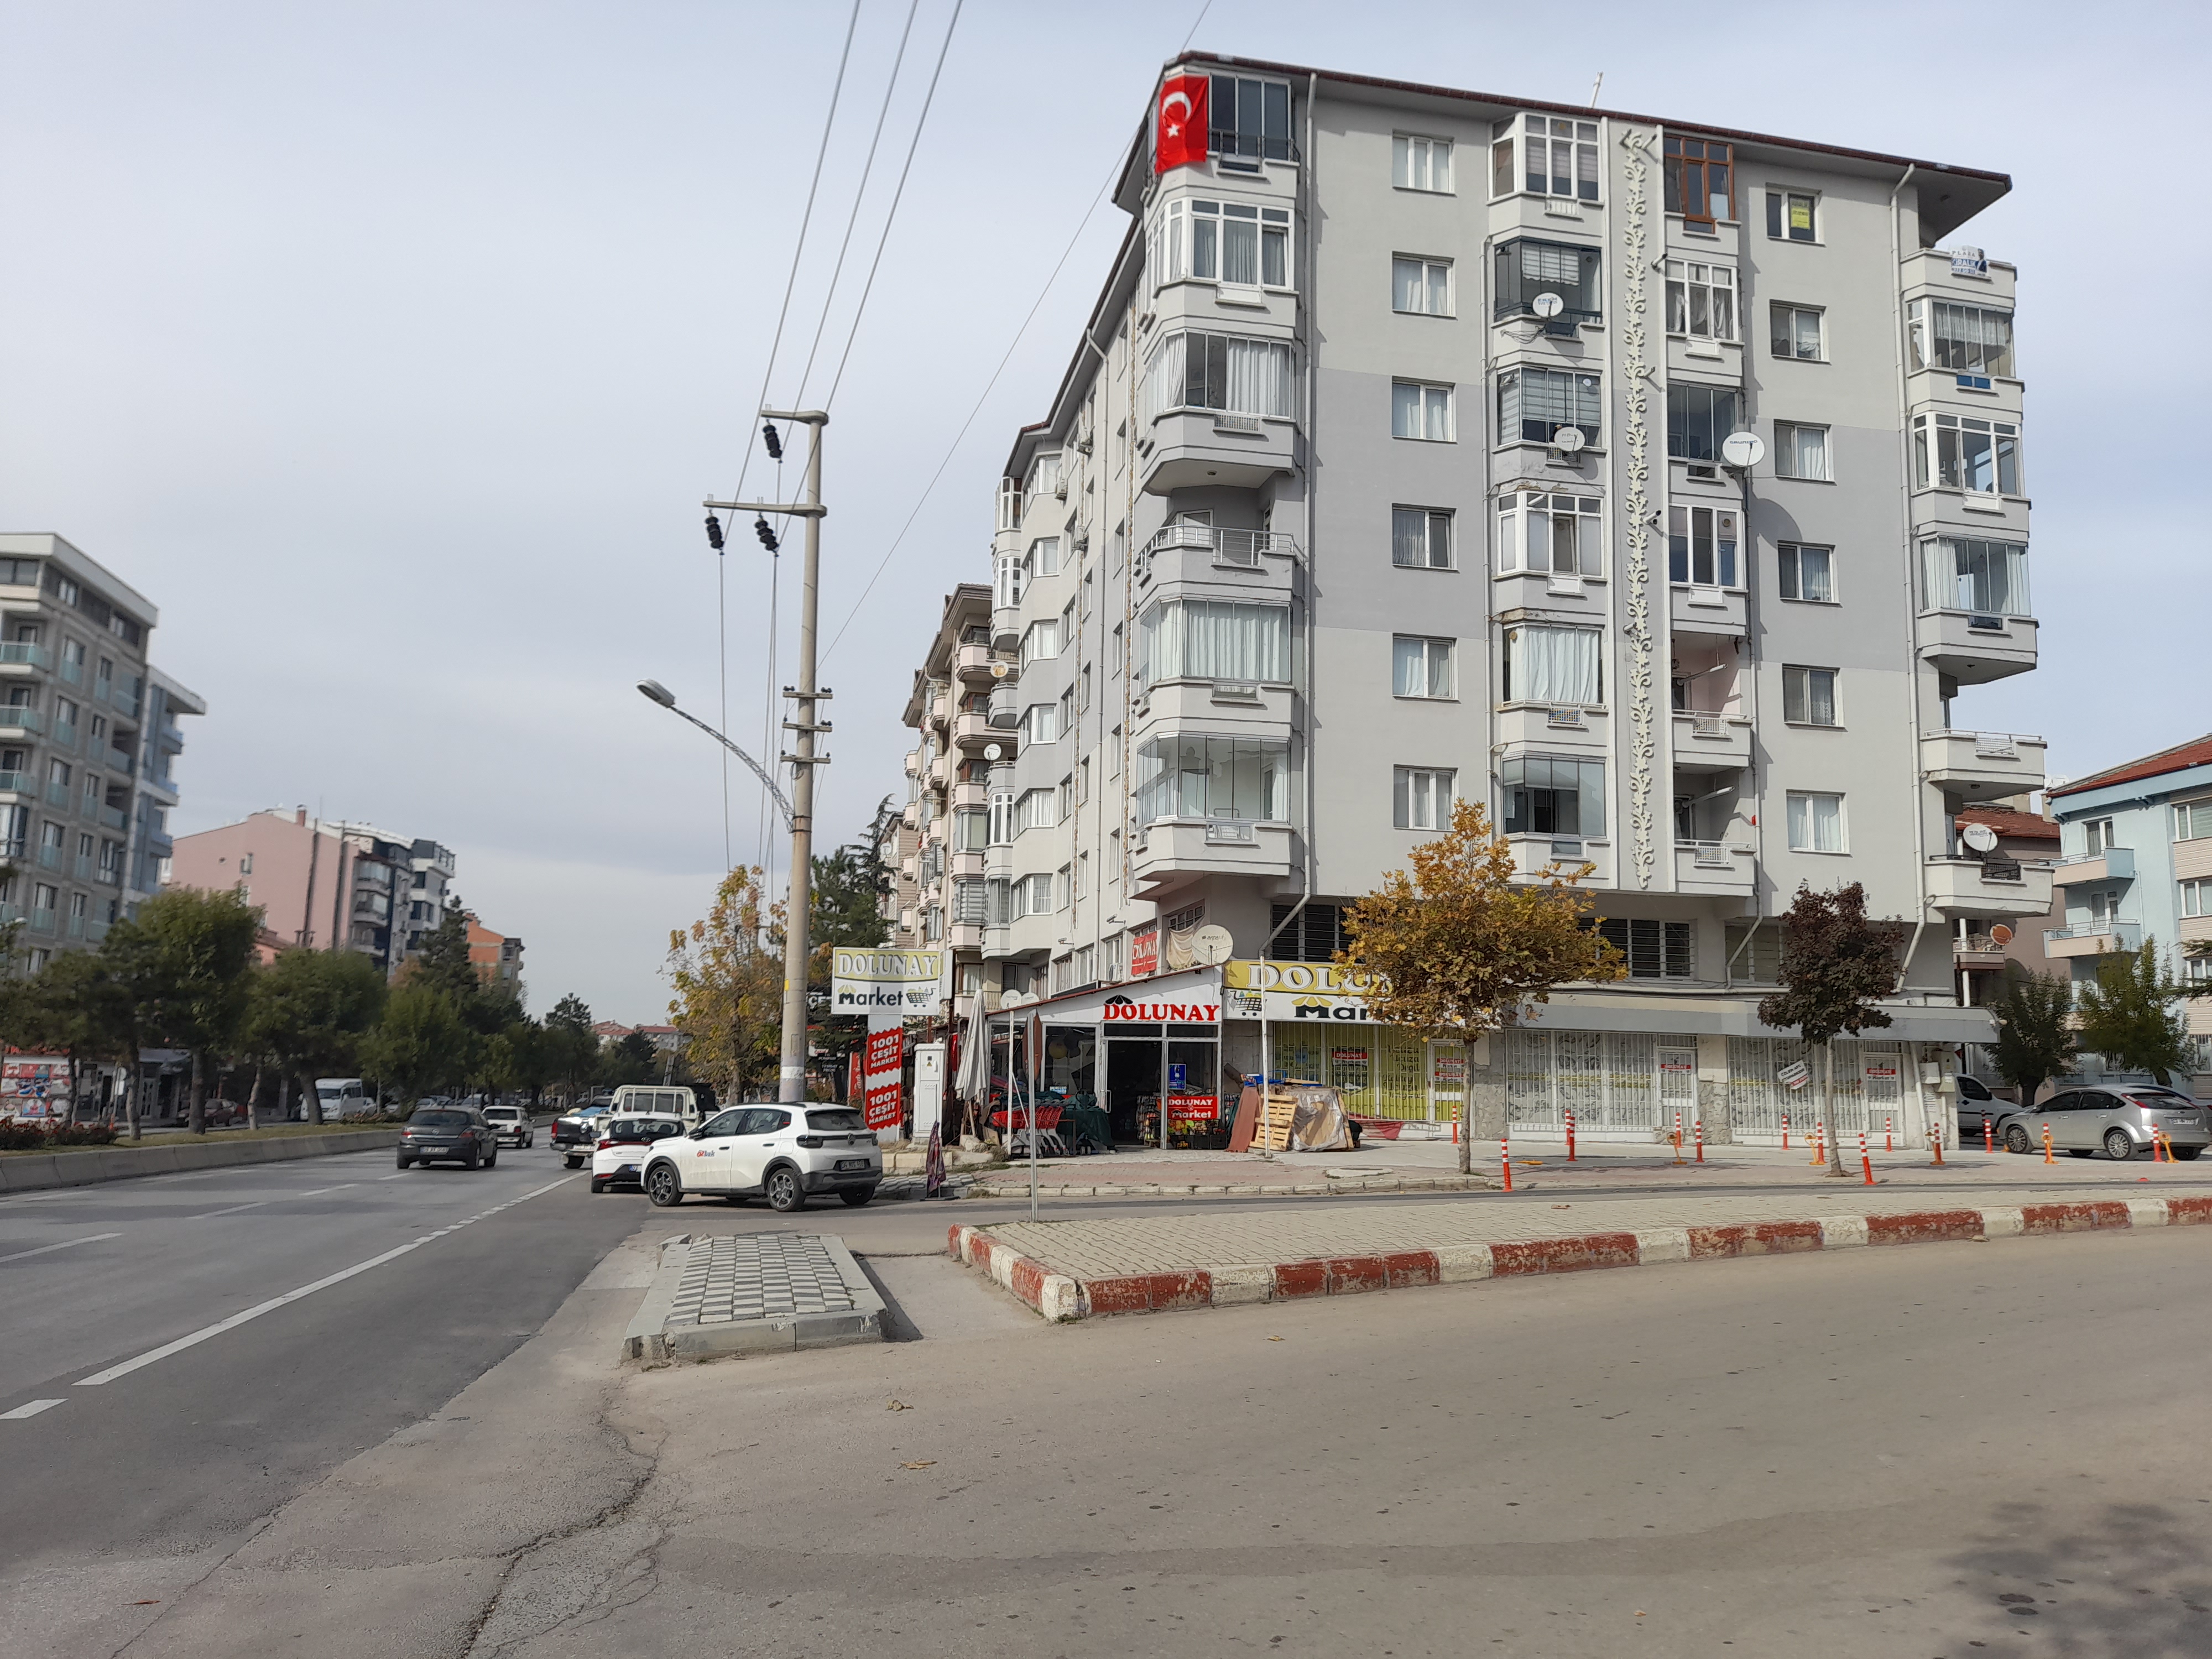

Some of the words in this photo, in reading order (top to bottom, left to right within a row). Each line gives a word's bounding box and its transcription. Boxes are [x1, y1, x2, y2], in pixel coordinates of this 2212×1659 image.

[838, 953, 937, 977] DOLUNAY
[1246, 964, 1391, 993] DOLU
[838, 986, 903, 1006] Market
[1103, 1003, 1220, 1021] DOLUNAY
[872, 1034, 899, 1050] 1001
[870, 1055, 898, 1069] MARKET
[871, 1045, 898, 1062] ÇEŞİT
[869, 1089, 897, 1106] 1001
[869, 1101, 896, 1118] ÇEŞİT
[1171, 1109, 1212, 1118] Market
[869, 1112, 896, 1125] MARKET
